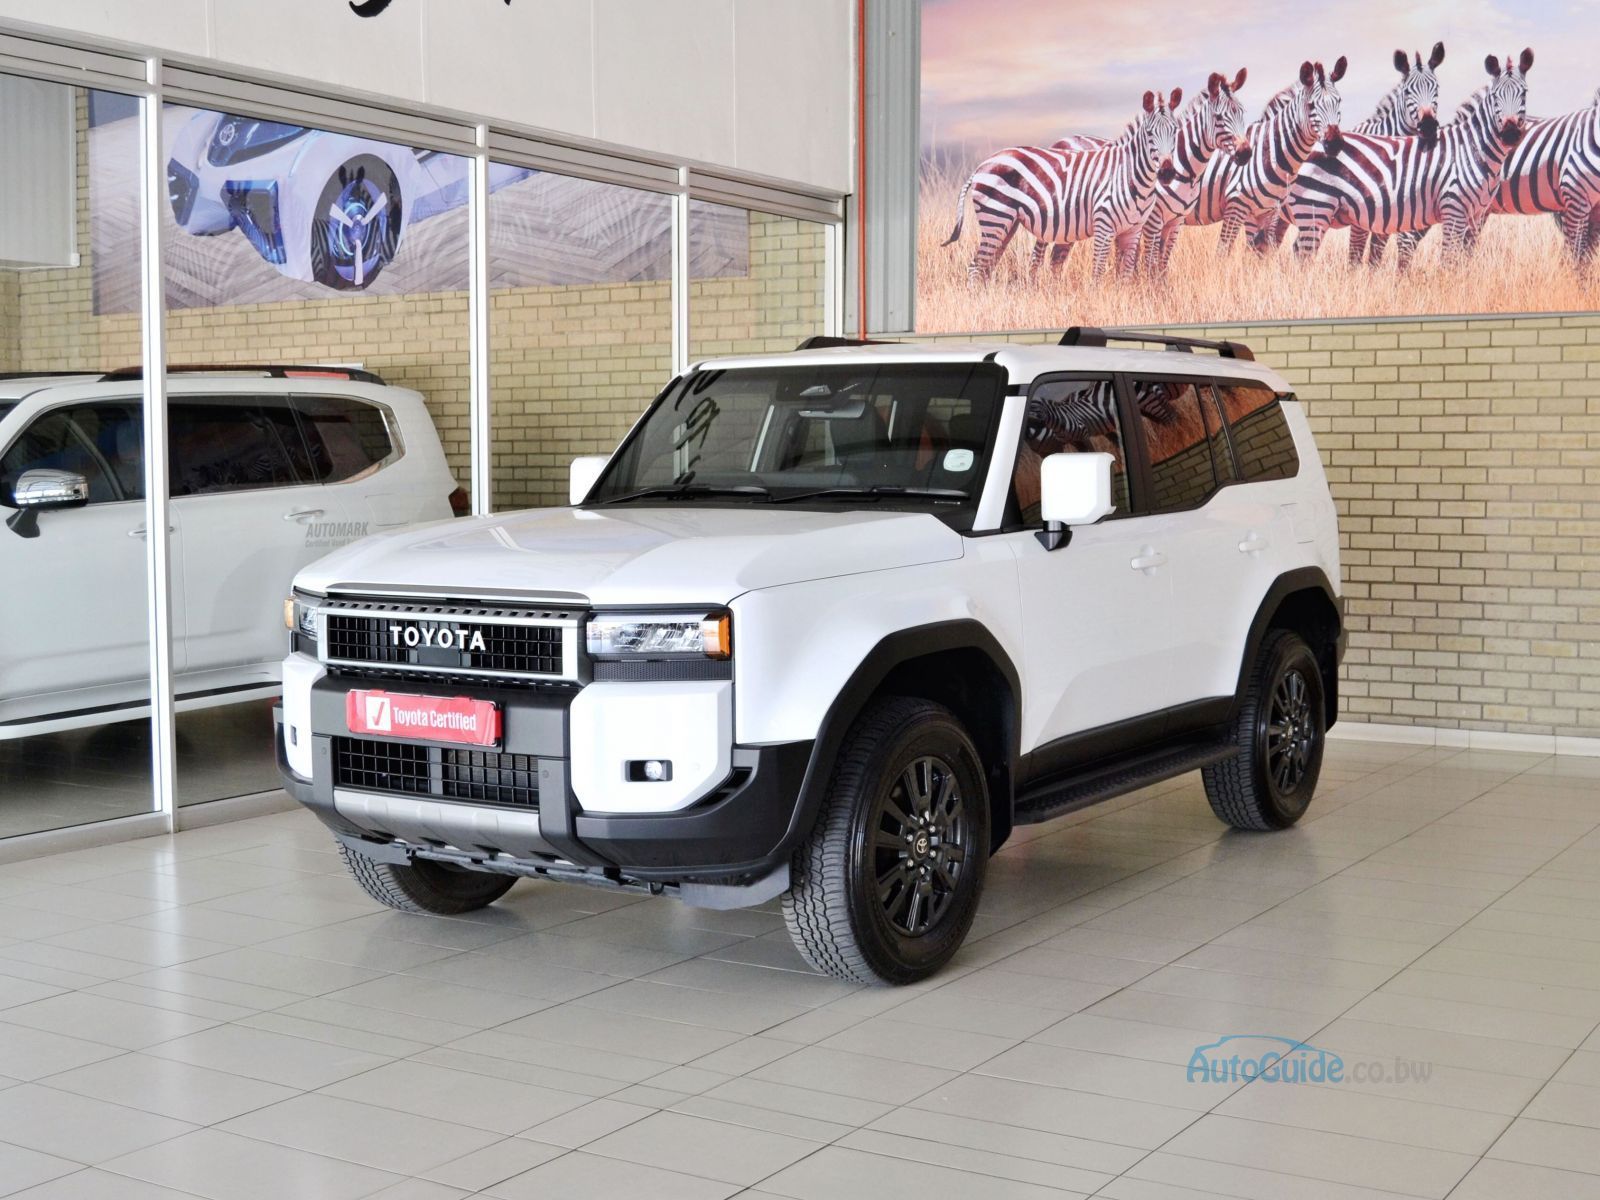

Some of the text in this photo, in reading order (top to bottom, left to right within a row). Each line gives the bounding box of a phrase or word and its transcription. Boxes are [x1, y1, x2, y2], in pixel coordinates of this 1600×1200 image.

[306, 521, 368, 538] AUTOMARK
[389, 626, 486, 650] TOYOTA
[394, 707, 477, 731] Toyota Certified
